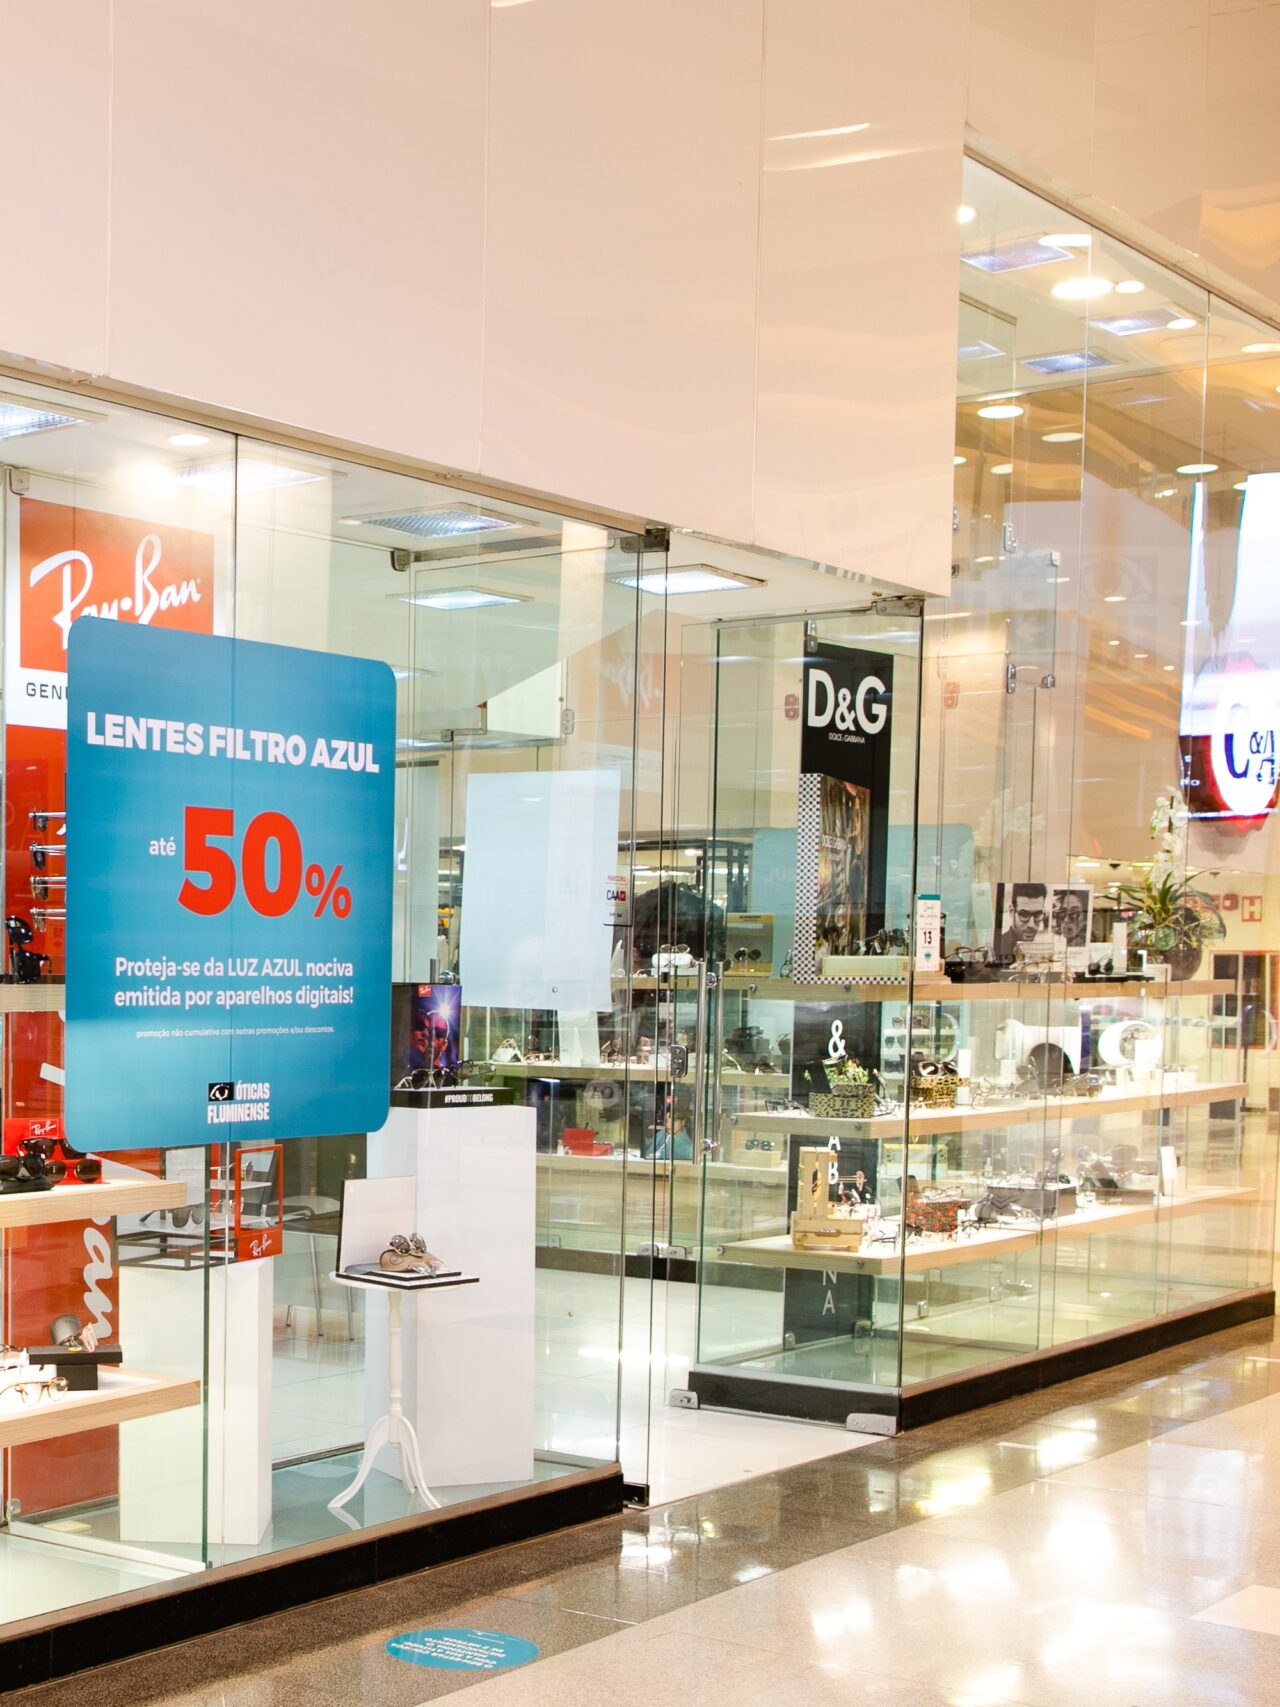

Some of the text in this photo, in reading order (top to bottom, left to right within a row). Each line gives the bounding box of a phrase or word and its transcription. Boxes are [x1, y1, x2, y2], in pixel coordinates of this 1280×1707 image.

[26, 682, 68, 700] GEN
[807, 668, 887, 734] D&G
[87, 711, 380, 773] LENTES FILTRO AZUL
[149, 806, 352, 920] até 50%
[115, 956, 353, 981] Proteja-se da LUZ AZUL nociva
[114, 985, 354, 1009] emitida por aparelhos digitais!
[171, 1029, 183, 1037] não
[235, 1027, 255, 1036] outras
[236, 1080, 270, 1100] ÓTICAS
[207, 1102, 270, 1124] FLUMINENSE
